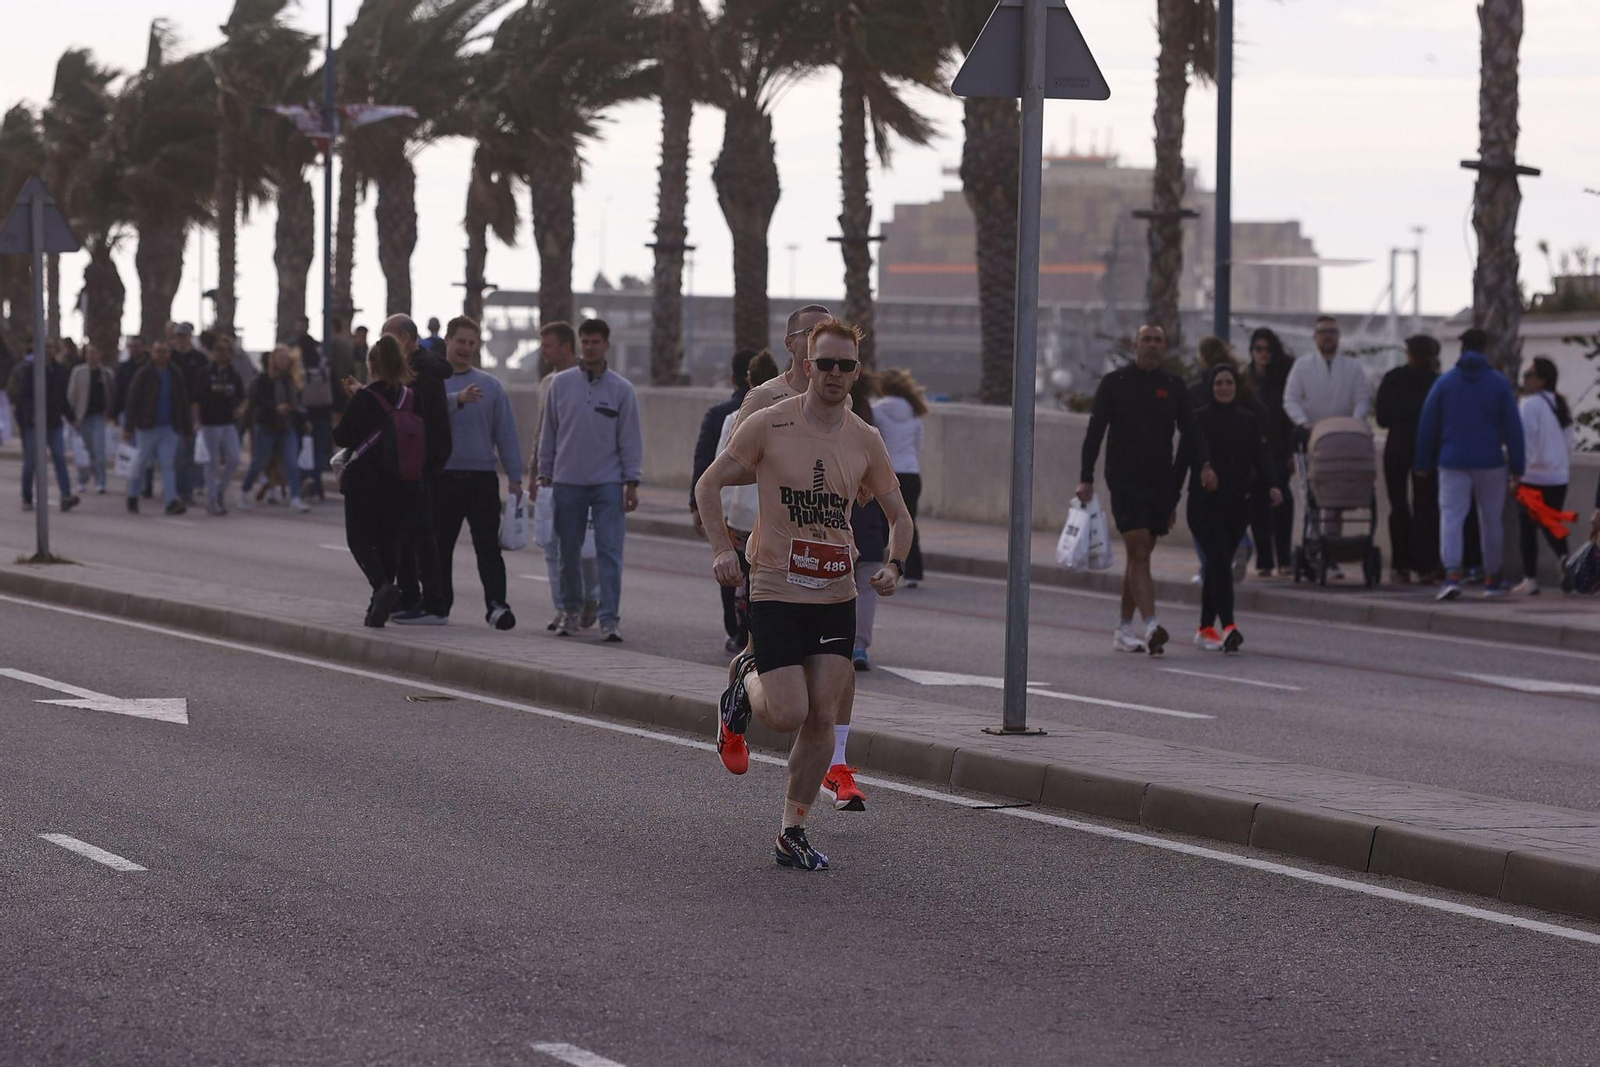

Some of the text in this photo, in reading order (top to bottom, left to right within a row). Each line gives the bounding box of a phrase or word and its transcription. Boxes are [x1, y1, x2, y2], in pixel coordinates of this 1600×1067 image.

[788, 505, 824, 528] RUN
[824, 518, 850, 530] 202
[823, 561, 846, 572] 486
